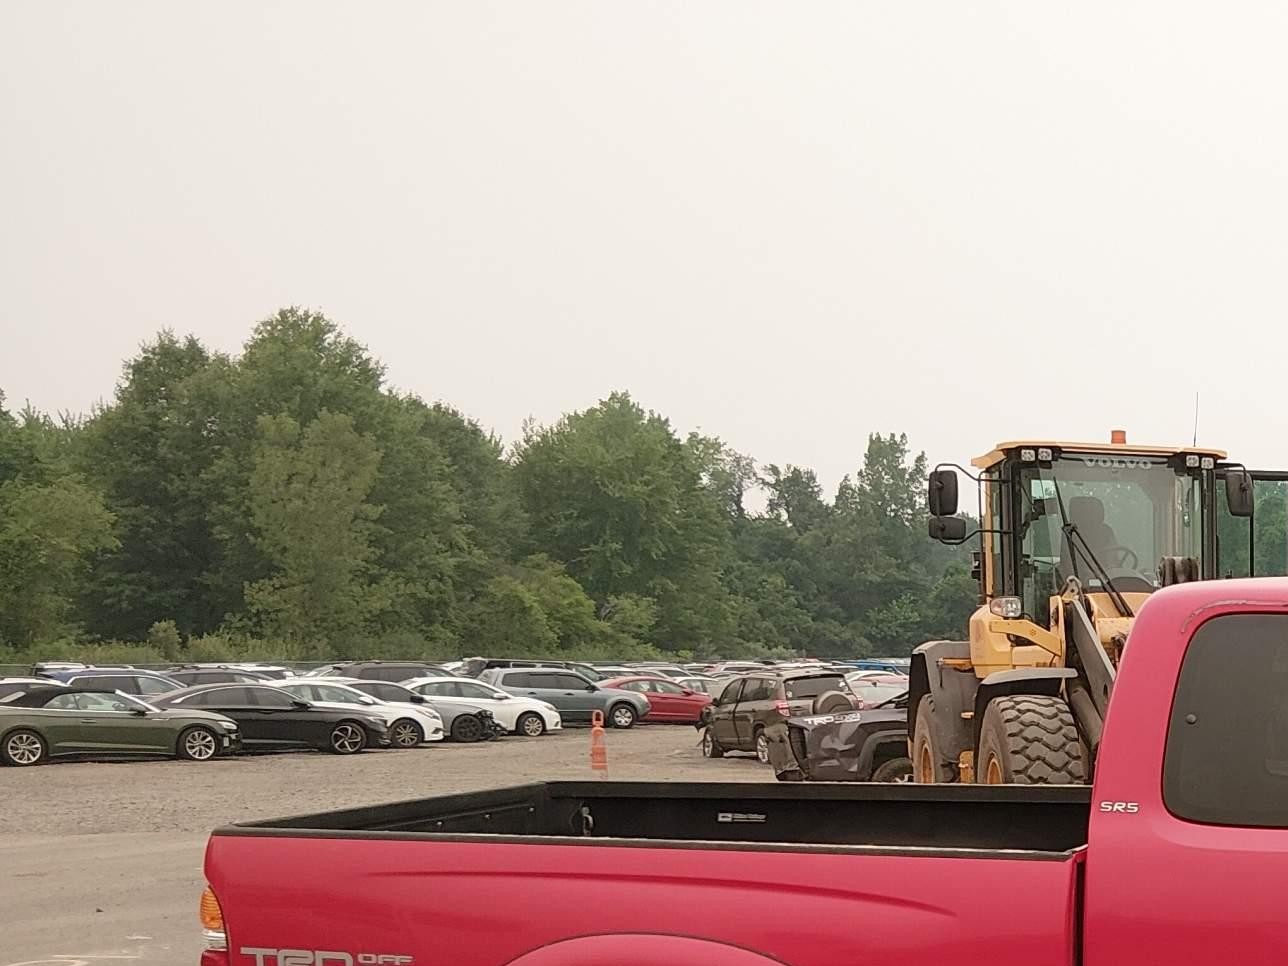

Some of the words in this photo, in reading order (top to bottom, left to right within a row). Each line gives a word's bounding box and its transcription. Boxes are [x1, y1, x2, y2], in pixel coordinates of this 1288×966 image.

[1084, 458, 1152, 470] VOLVO
[803, 715, 835, 726] TRD
[1100, 801, 1139, 813] SR5
[357, 953, 414, 966] OFF
